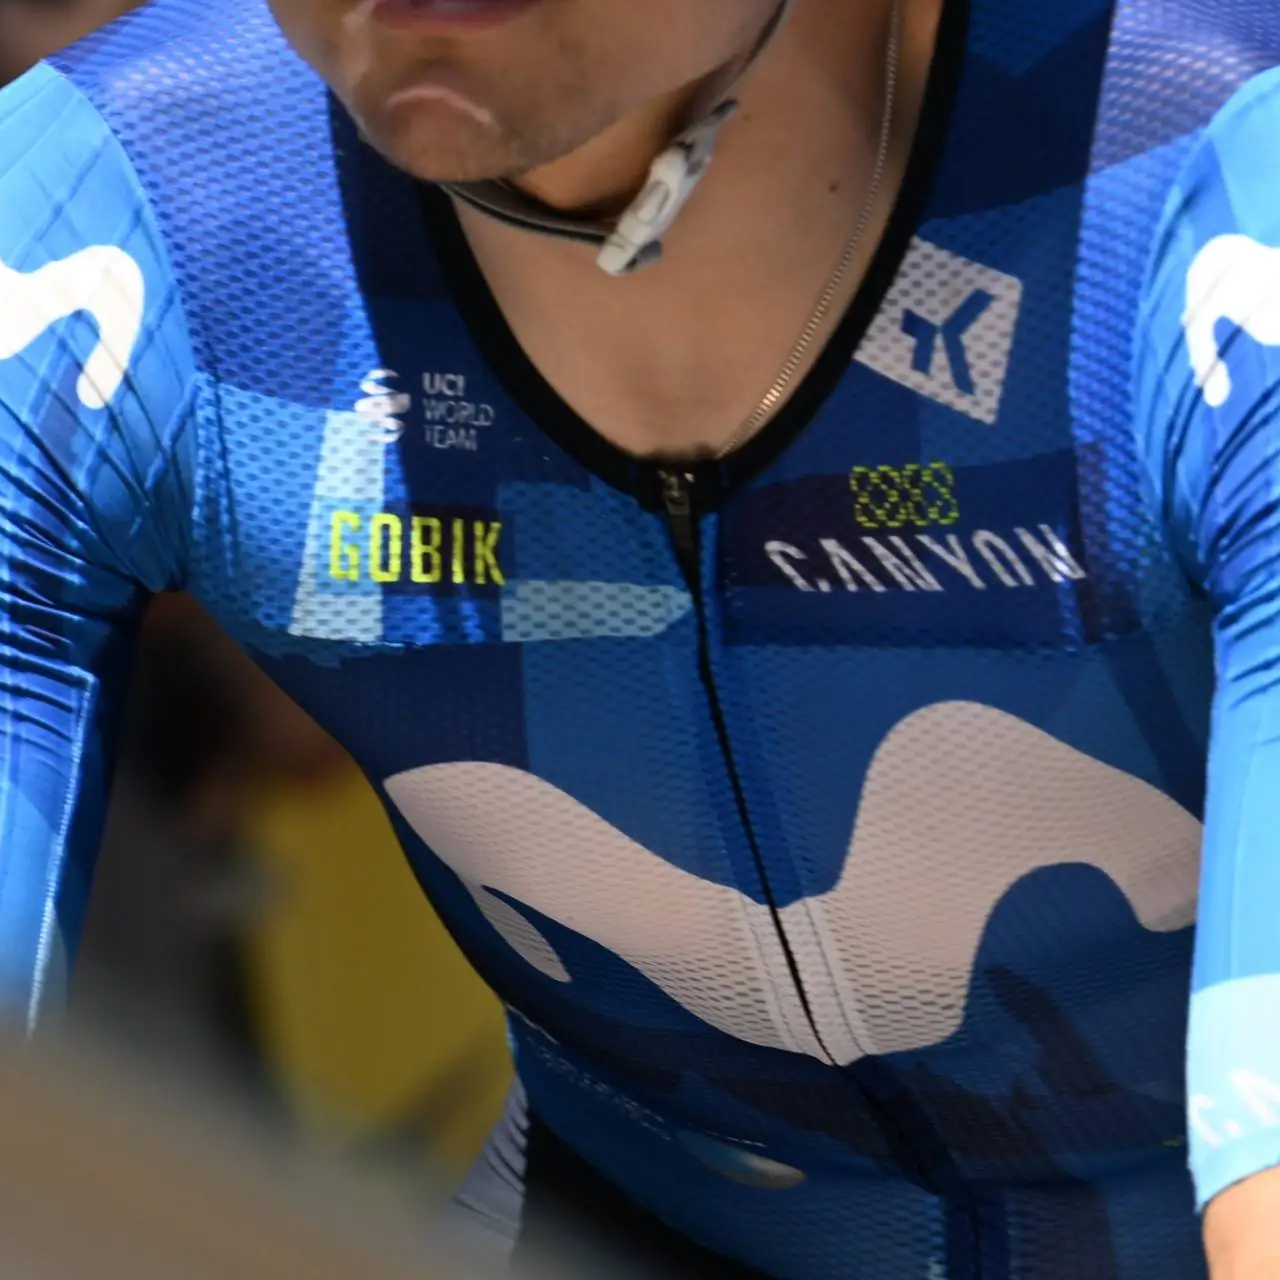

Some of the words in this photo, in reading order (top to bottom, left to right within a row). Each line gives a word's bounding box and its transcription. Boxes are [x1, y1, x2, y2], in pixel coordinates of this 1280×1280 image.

[422, 372, 465, 397] UCI
[422, 398, 495, 426] WORLD
[423, 424, 477, 451] TEAM
[329, 510, 506, 586] GOBIK
[764, 523, 1087, 593] CANYON
